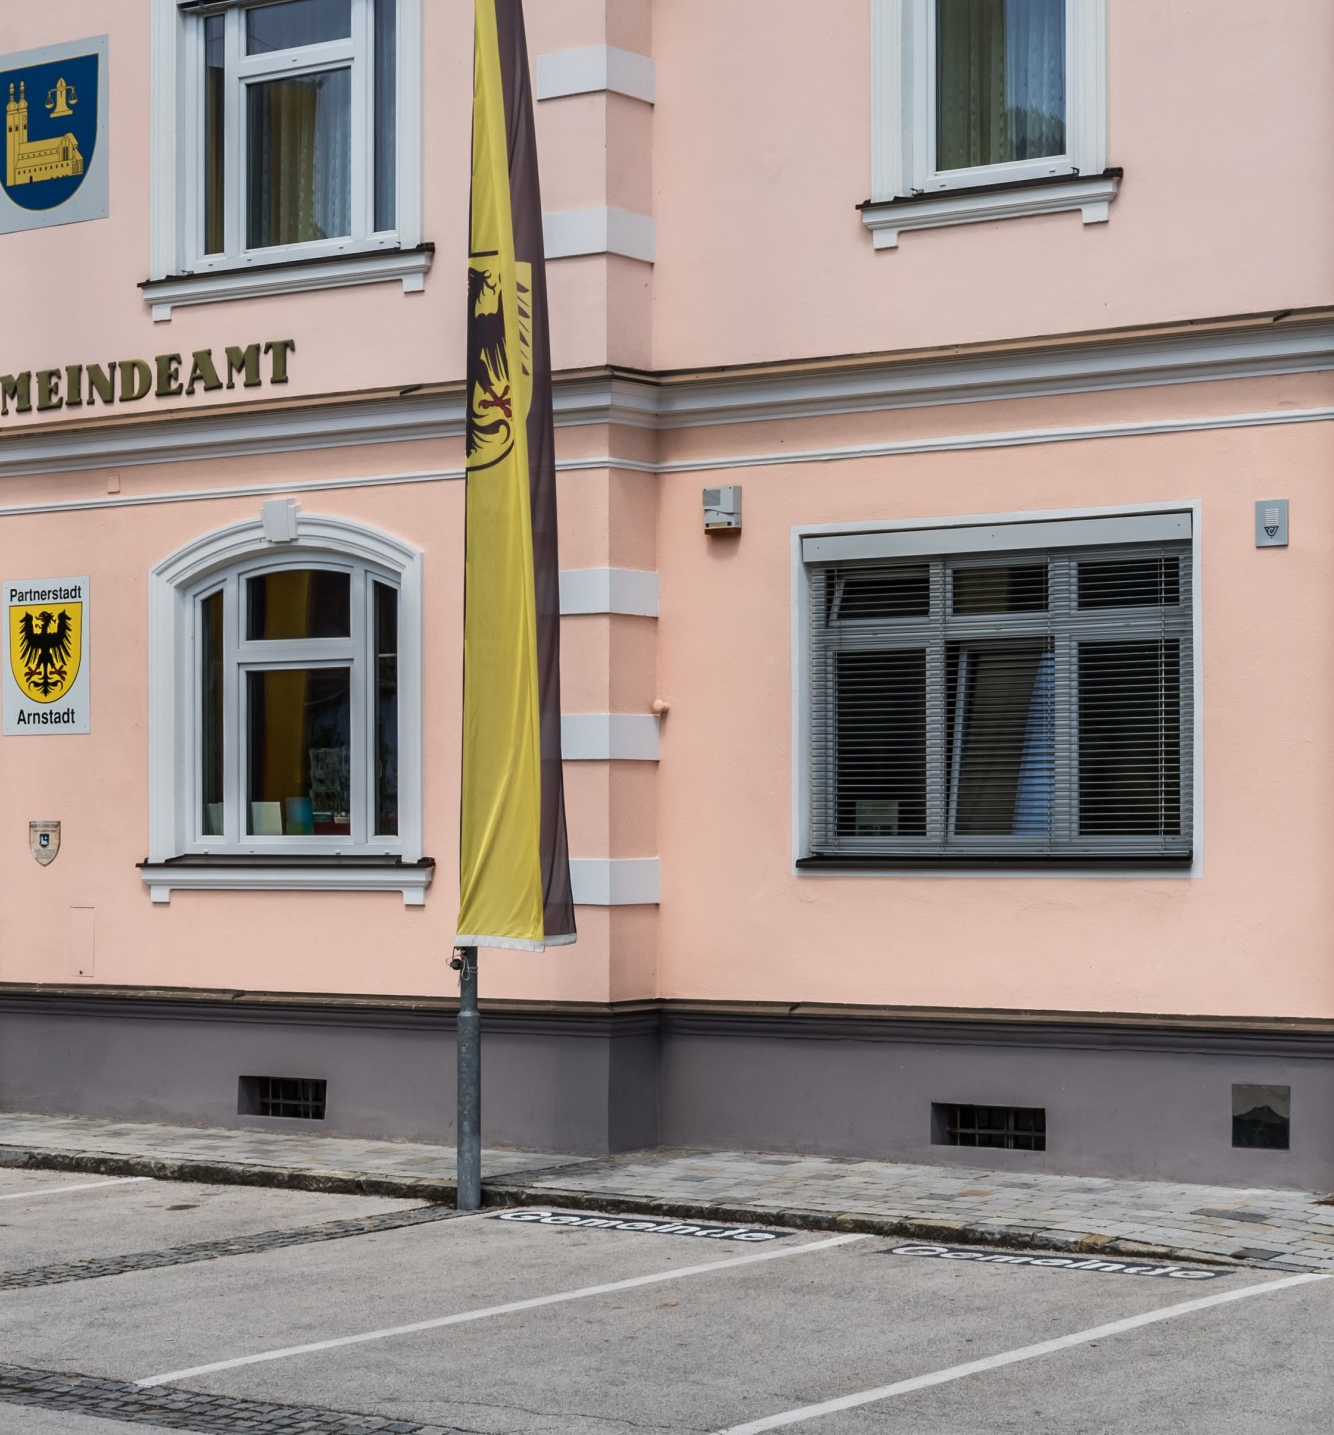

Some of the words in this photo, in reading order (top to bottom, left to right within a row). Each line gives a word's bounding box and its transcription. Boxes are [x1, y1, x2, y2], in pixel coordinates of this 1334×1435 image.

[9, 585, 82, 602] Partnerstadt
[17, 708, 76, 725] Arnstadt
[499, 1210, 777, 1242] Gemeinde
[891, 1246, 1217, 1279] Gemeinde
